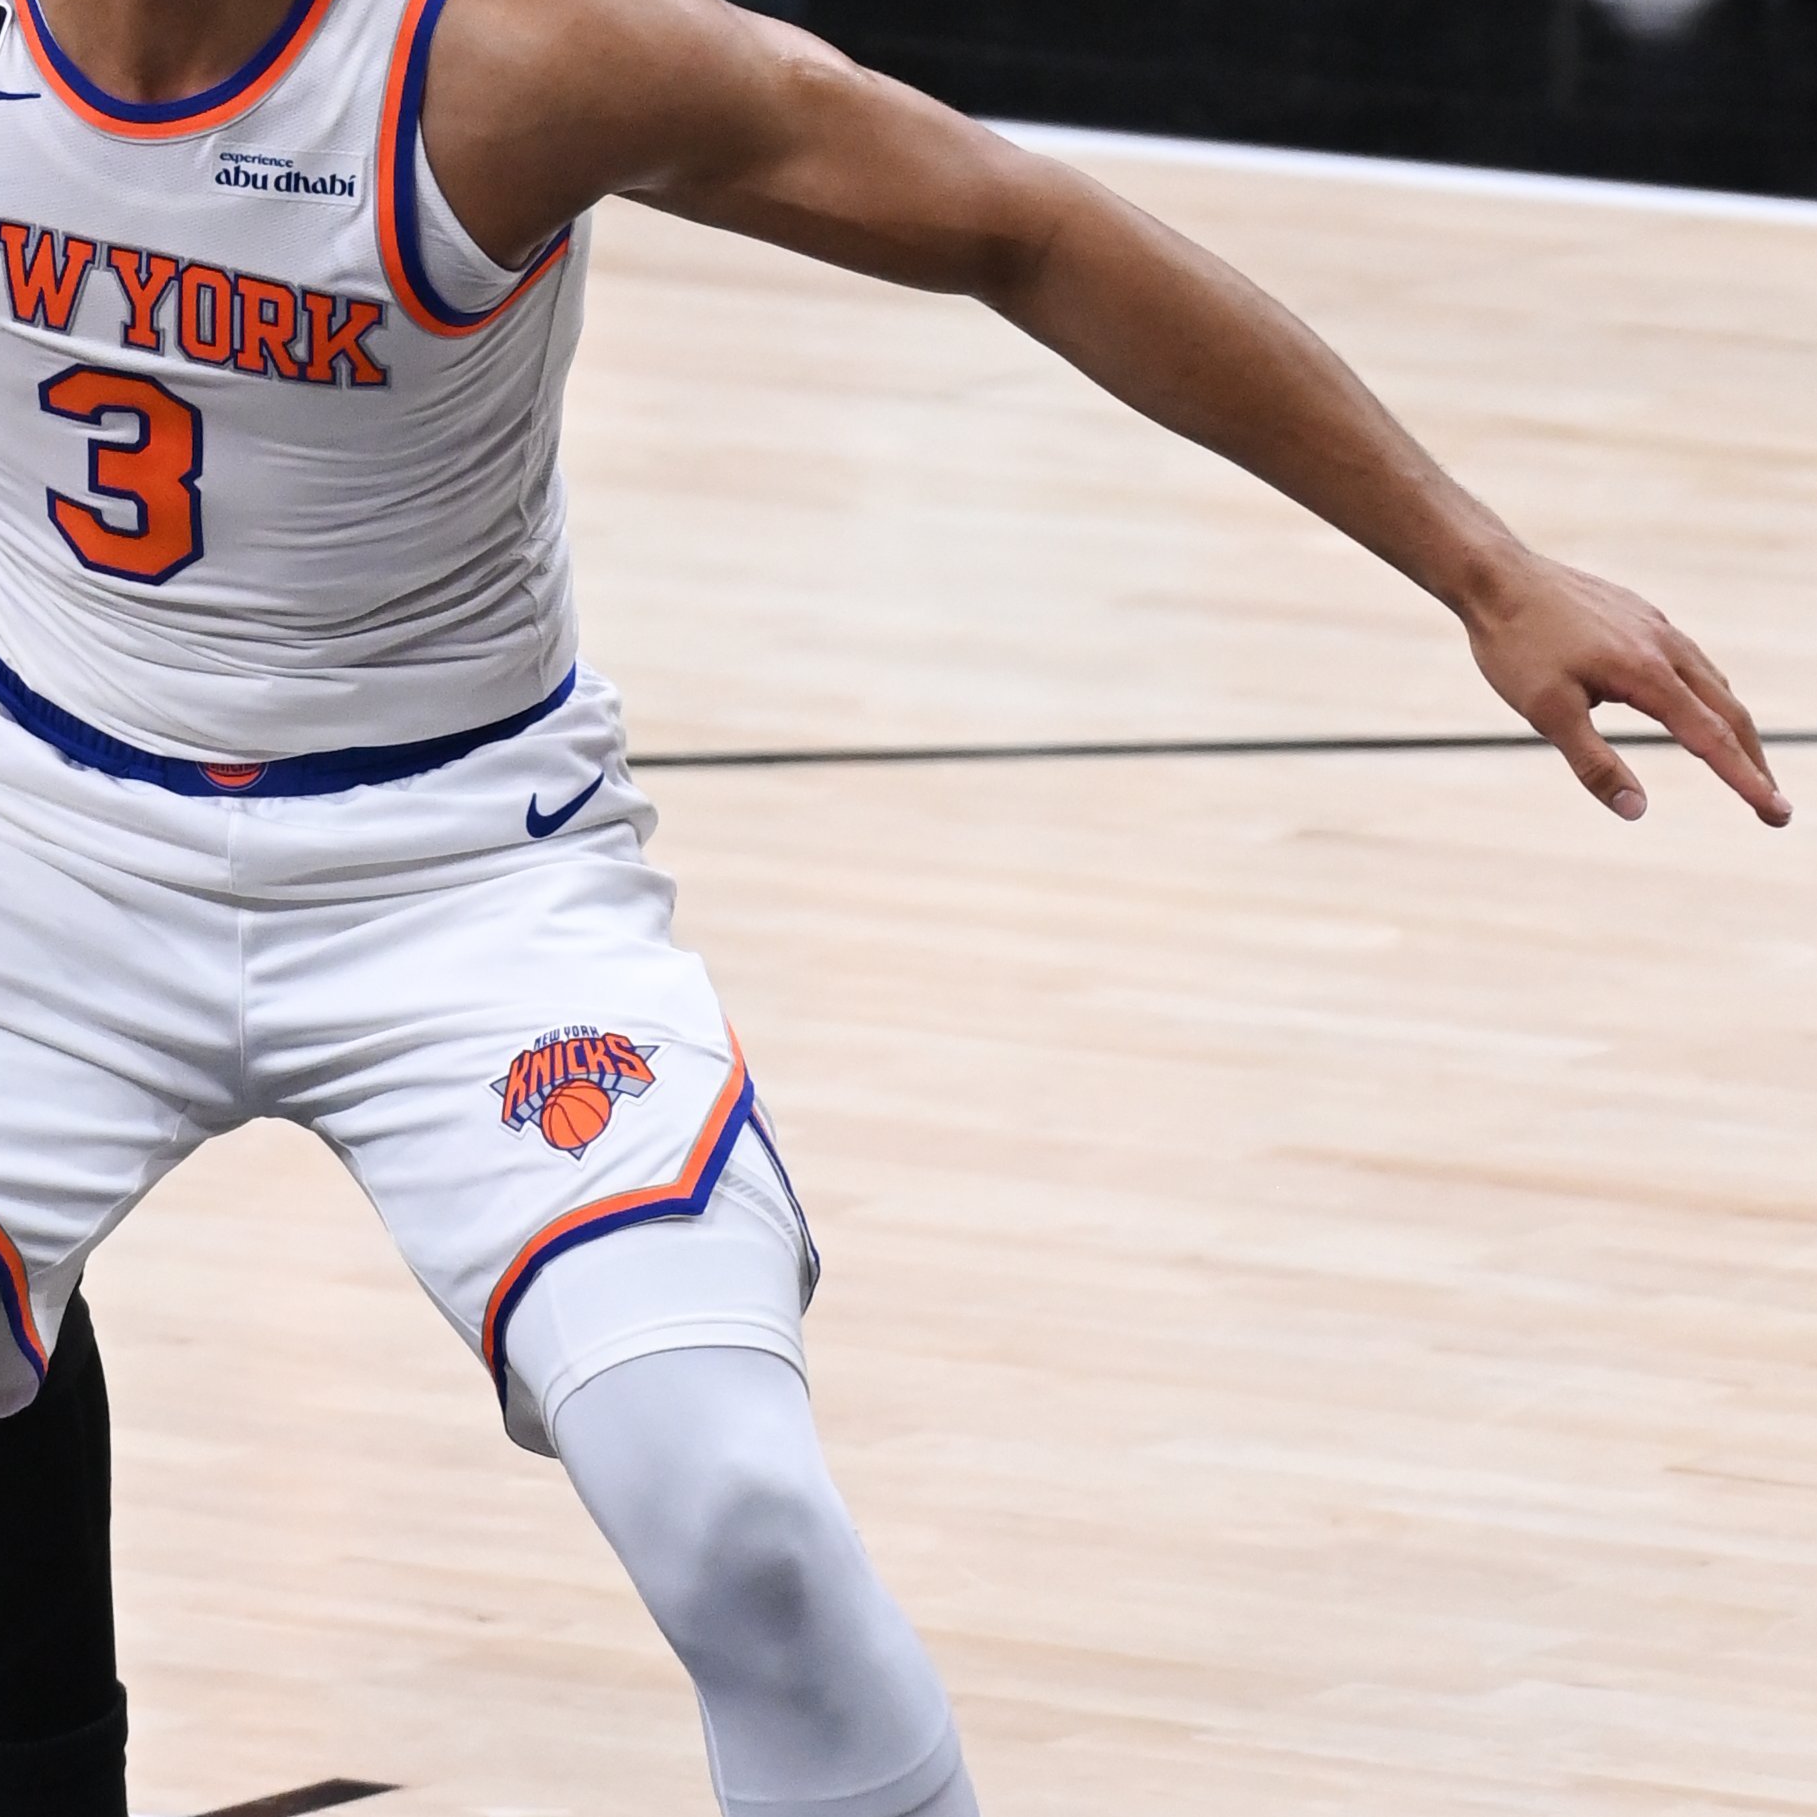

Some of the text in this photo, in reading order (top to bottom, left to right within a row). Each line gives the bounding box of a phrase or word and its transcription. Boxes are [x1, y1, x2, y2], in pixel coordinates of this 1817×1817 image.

[214, 165, 269, 191] abu
[219, 151, 294, 168] experience
[107, 242, 390, 389] YORK
[37, 362, 205, 586] 3
[533, 1024, 601, 1051] NEW YORK
[500, 1031, 657, 1128] KNICKS
